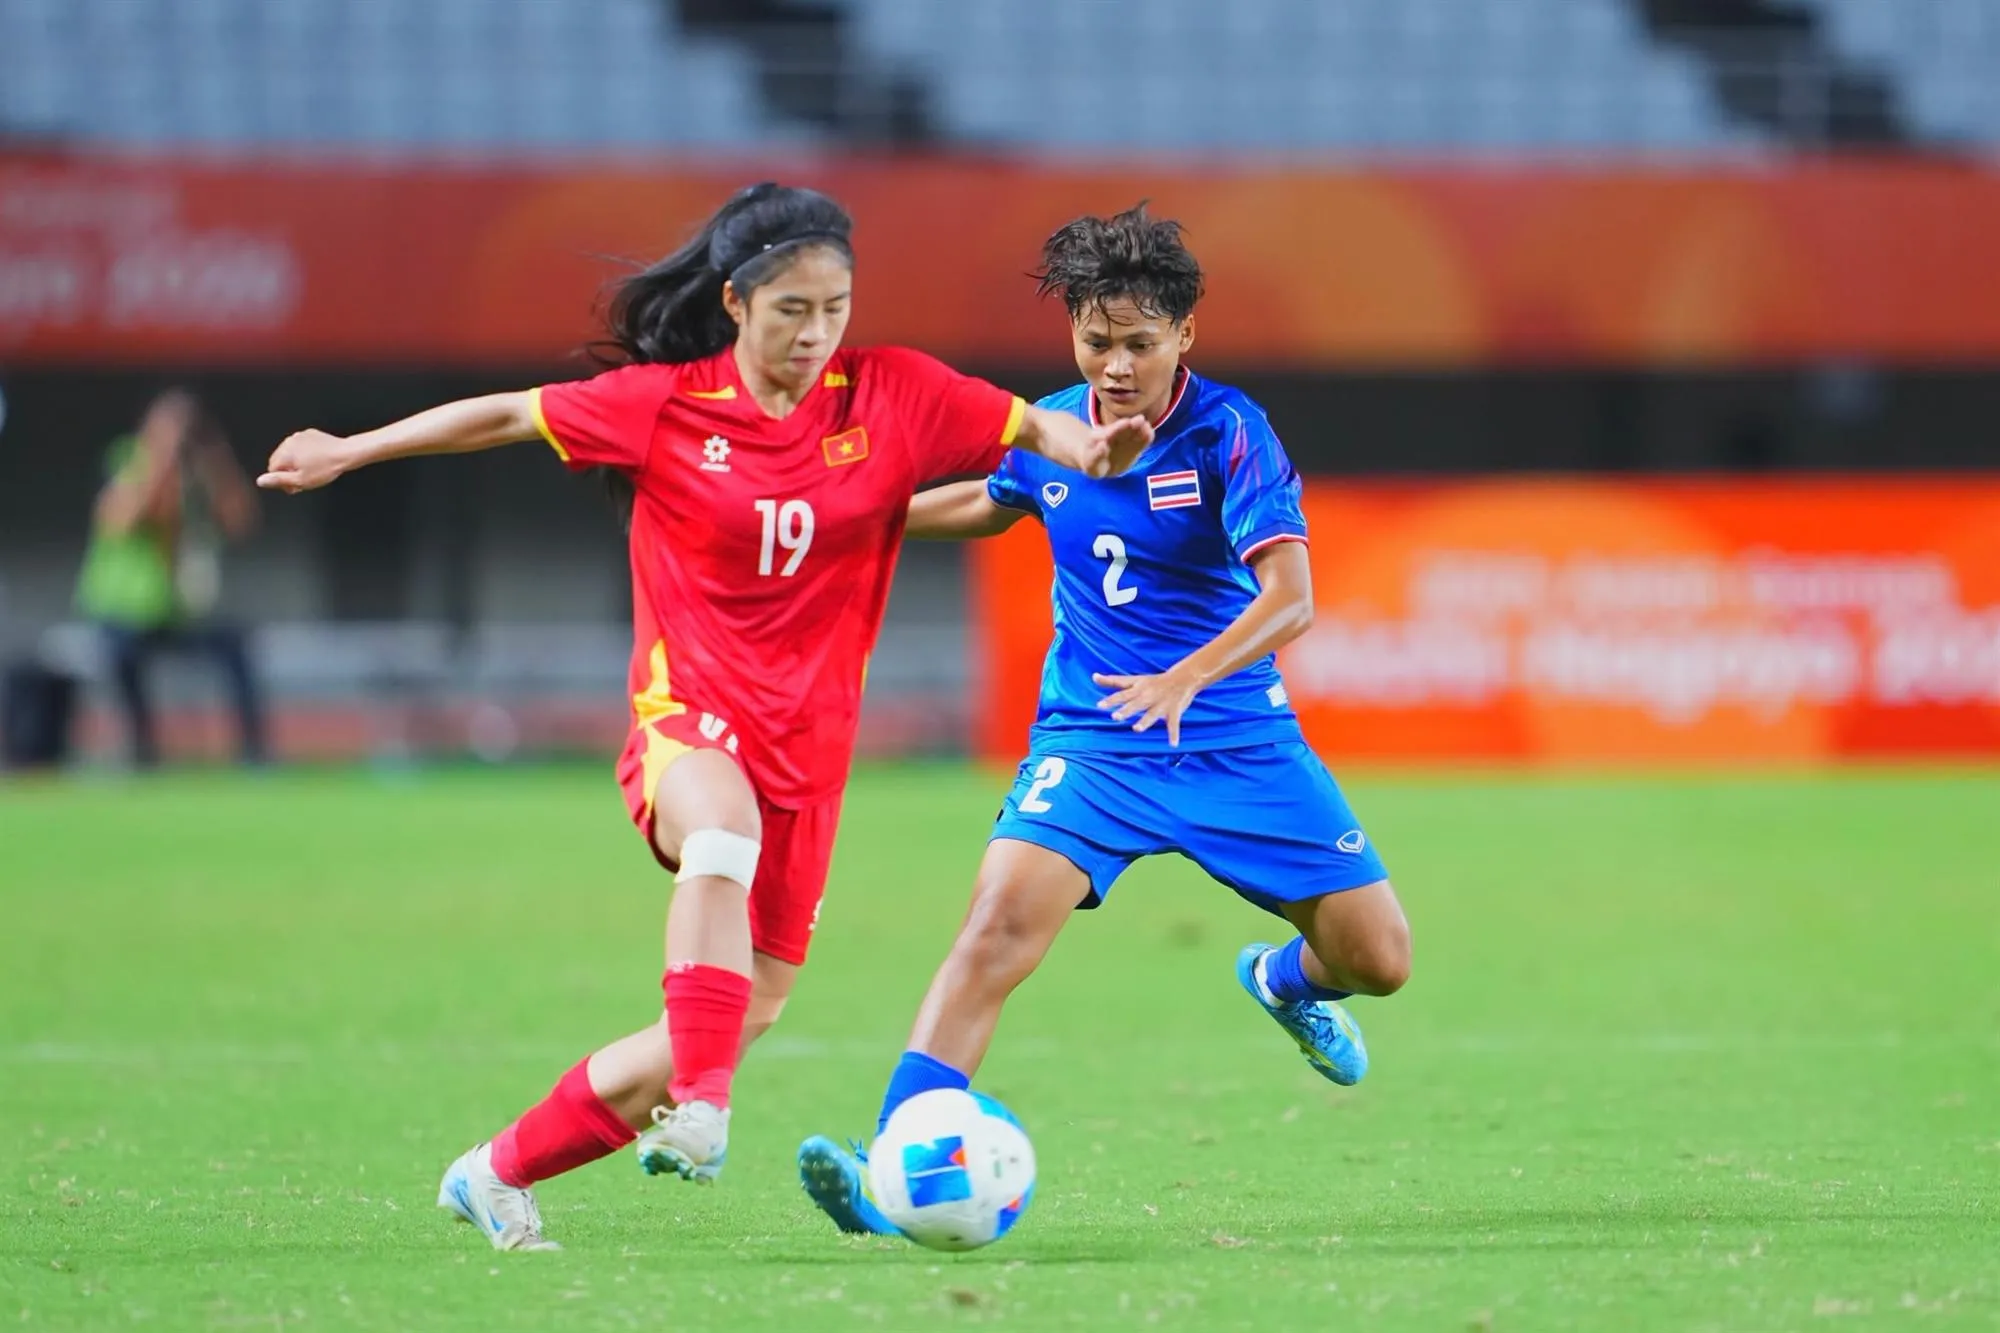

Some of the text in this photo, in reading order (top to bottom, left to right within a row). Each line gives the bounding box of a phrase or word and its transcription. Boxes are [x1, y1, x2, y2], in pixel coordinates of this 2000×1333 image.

[755, 500, 815, 576] 19
[1093, 535, 1138, 606] 2
[1018, 757, 1066, 813] 2
